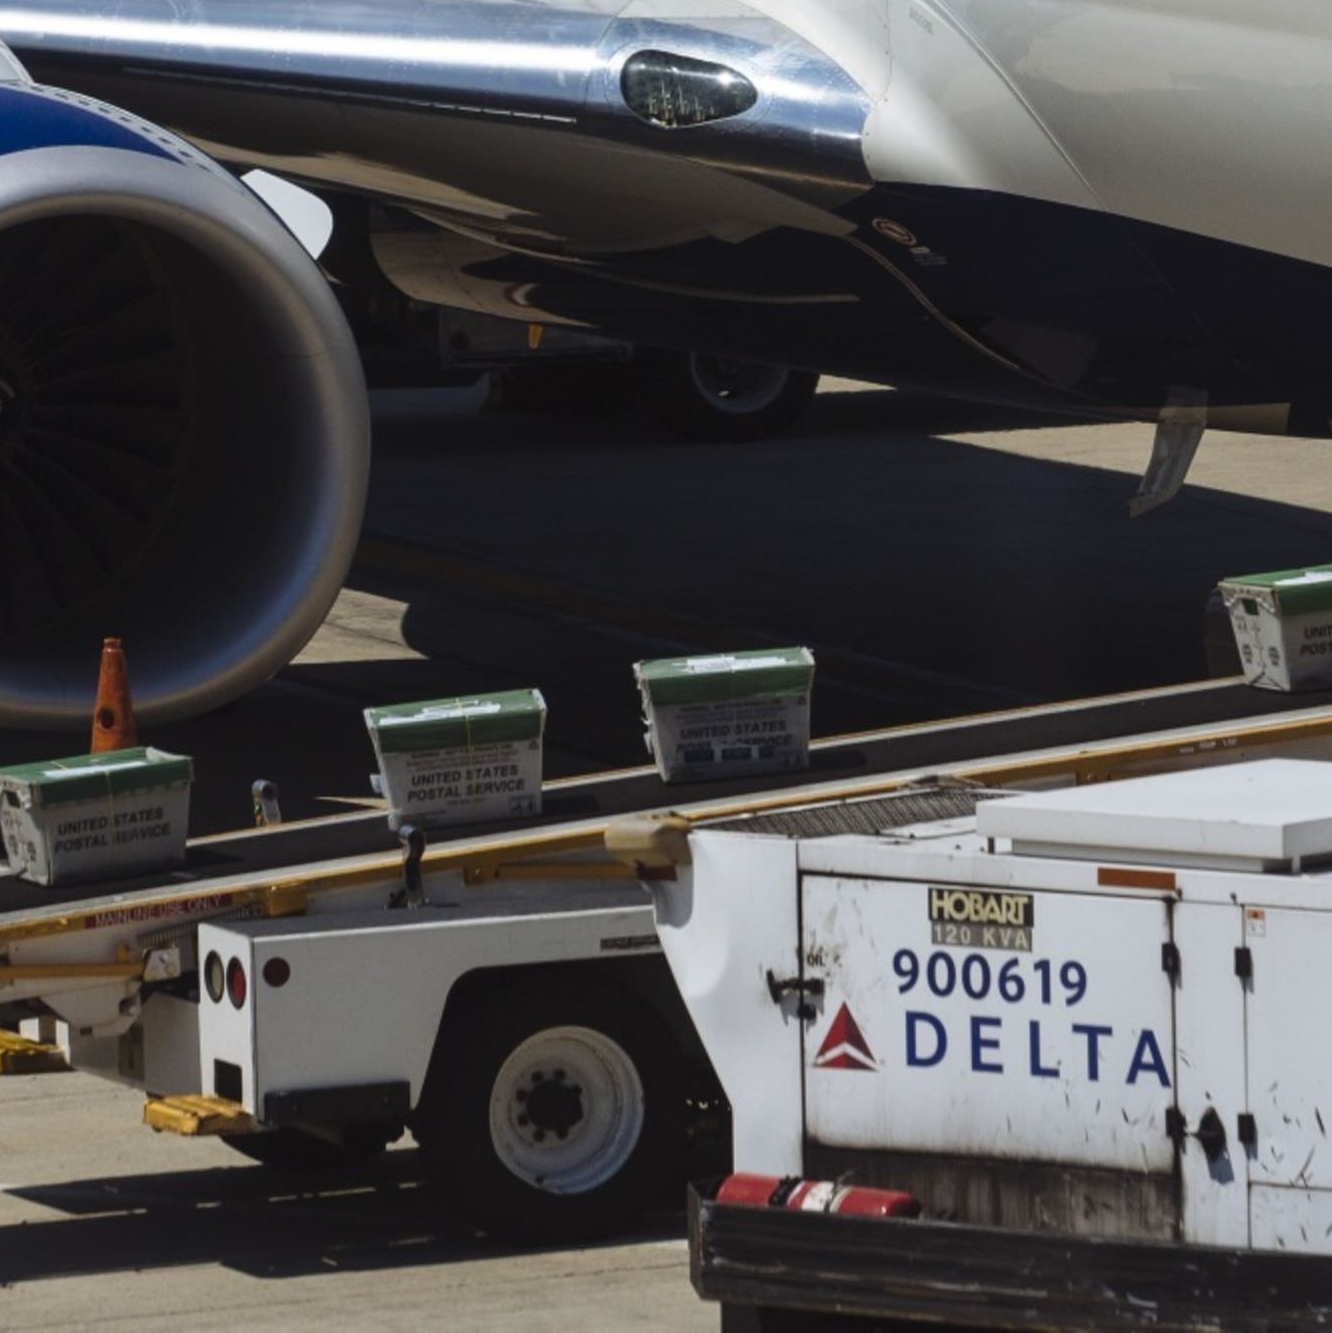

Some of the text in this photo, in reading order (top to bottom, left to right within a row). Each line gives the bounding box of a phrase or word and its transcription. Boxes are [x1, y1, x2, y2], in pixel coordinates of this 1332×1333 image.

[680, 718, 787, 740] UNITED STATES
[407, 785, 461, 802] POSTAL
[466, 778, 525, 796] SERVICE
[411, 764, 519, 787] UNITED STATES
[57, 806, 164, 836] UNITED STATES
[54, 835, 108, 853] POSTAL
[113, 824, 171, 844] SERVICE
[931, 888, 1029, 926] HOBART
[934, 923, 1029, 950] 120 KVA
[892, 948, 1088, 1007] 900619
[905, 1010, 1172, 1088] DELTA
